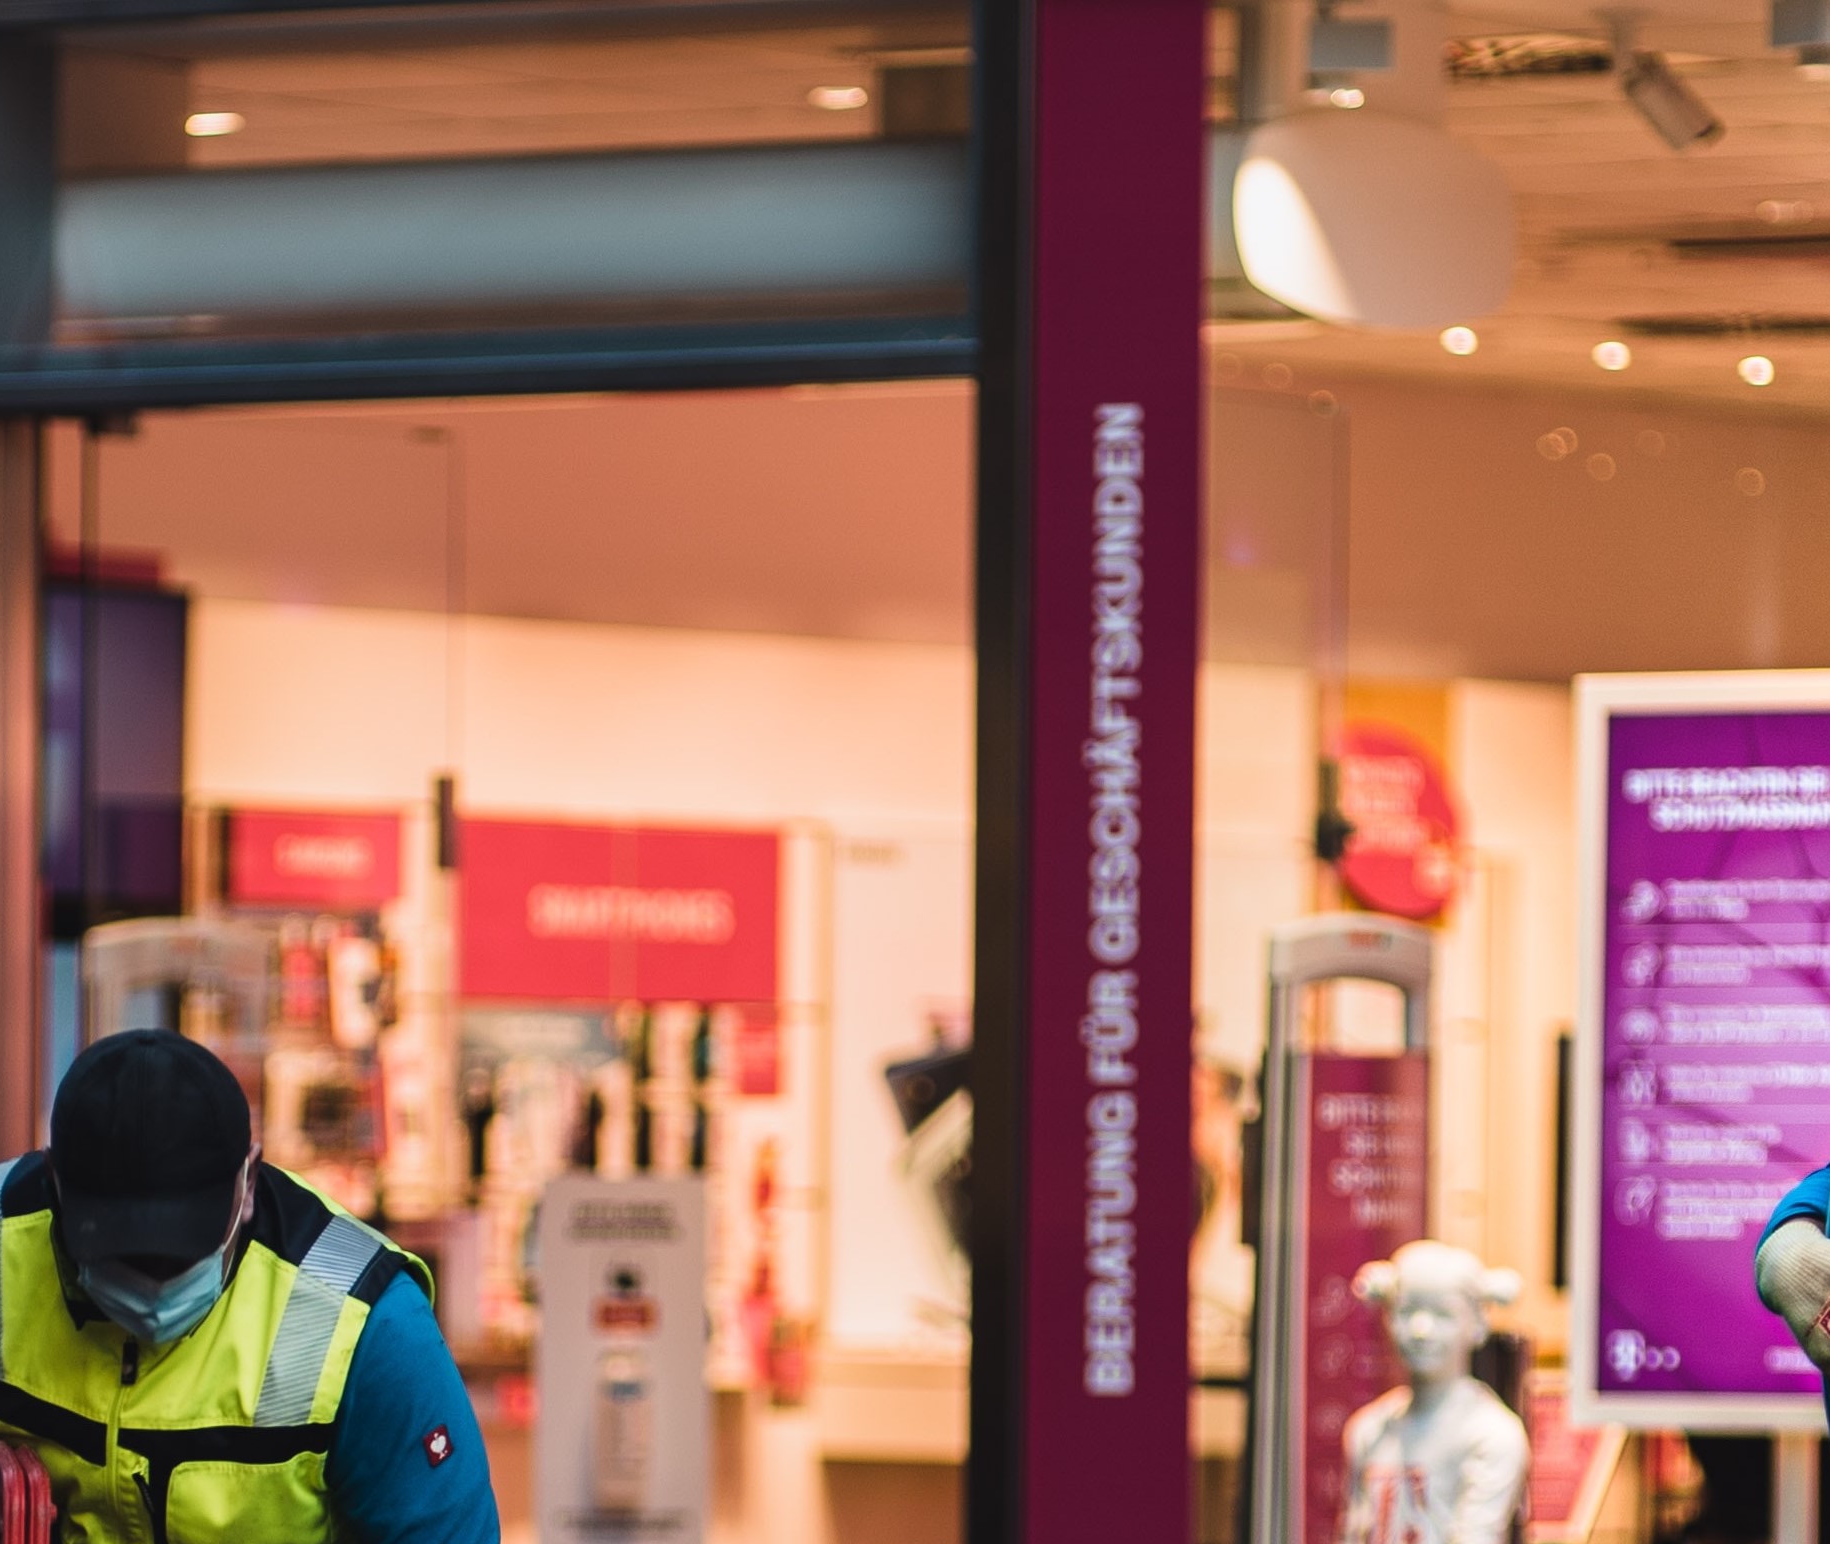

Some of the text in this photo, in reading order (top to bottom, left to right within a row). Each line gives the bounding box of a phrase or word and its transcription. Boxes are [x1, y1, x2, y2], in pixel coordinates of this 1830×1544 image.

[1080, 402, 1144, 1394] BERATUNG FÜR GESCHÄFTSKUNDEN
